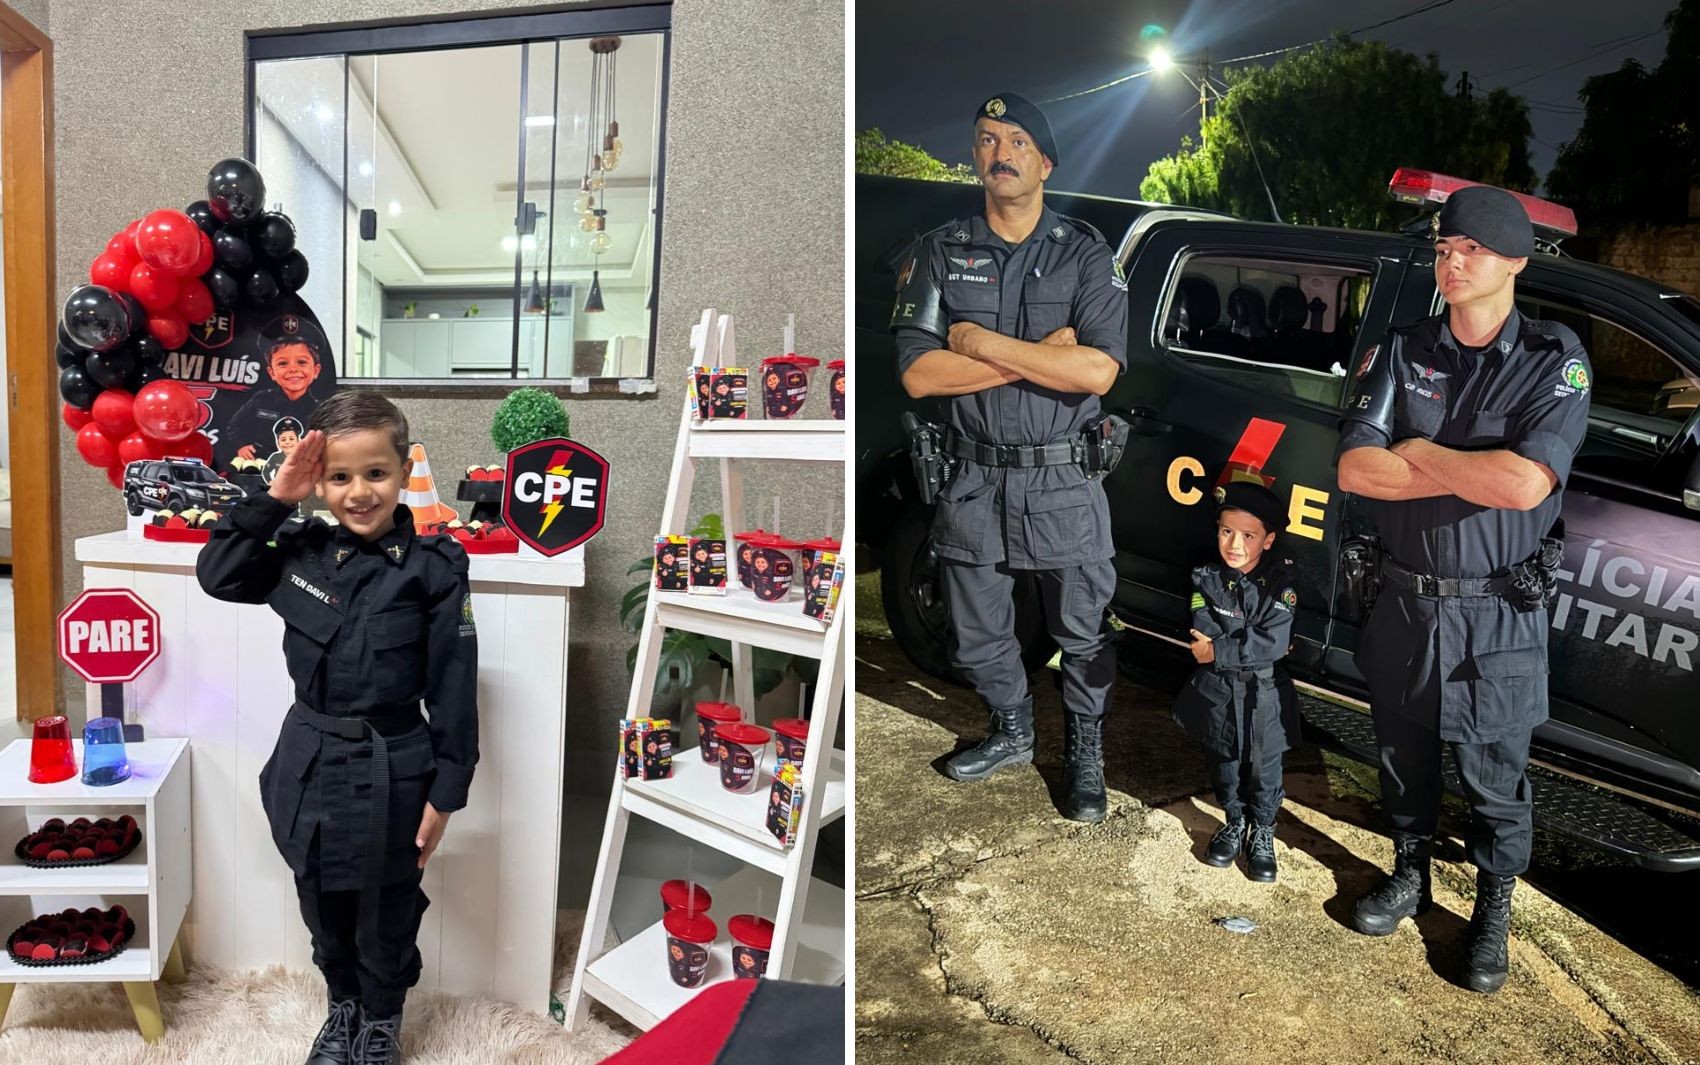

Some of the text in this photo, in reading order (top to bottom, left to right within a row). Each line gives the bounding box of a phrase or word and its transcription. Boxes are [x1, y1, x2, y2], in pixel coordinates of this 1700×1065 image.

[948, 273, 960, 281] SGT
[962, 274, 988, 283] URBANO
[206, 315, 229, 331] PE
[160, 352, 261, 385] AVI LUÍS
[143, 486, 158, 498] CPE
[514, 471, 597, 509] CPE
[1166, 456, 1330, 542] CE
[291, 574, 307, 589] TEN
[306, 584, 325, 600] DAVI
[69, 619, 149, 653] PARE
[1551, 592, 1699, 672] ITAR
